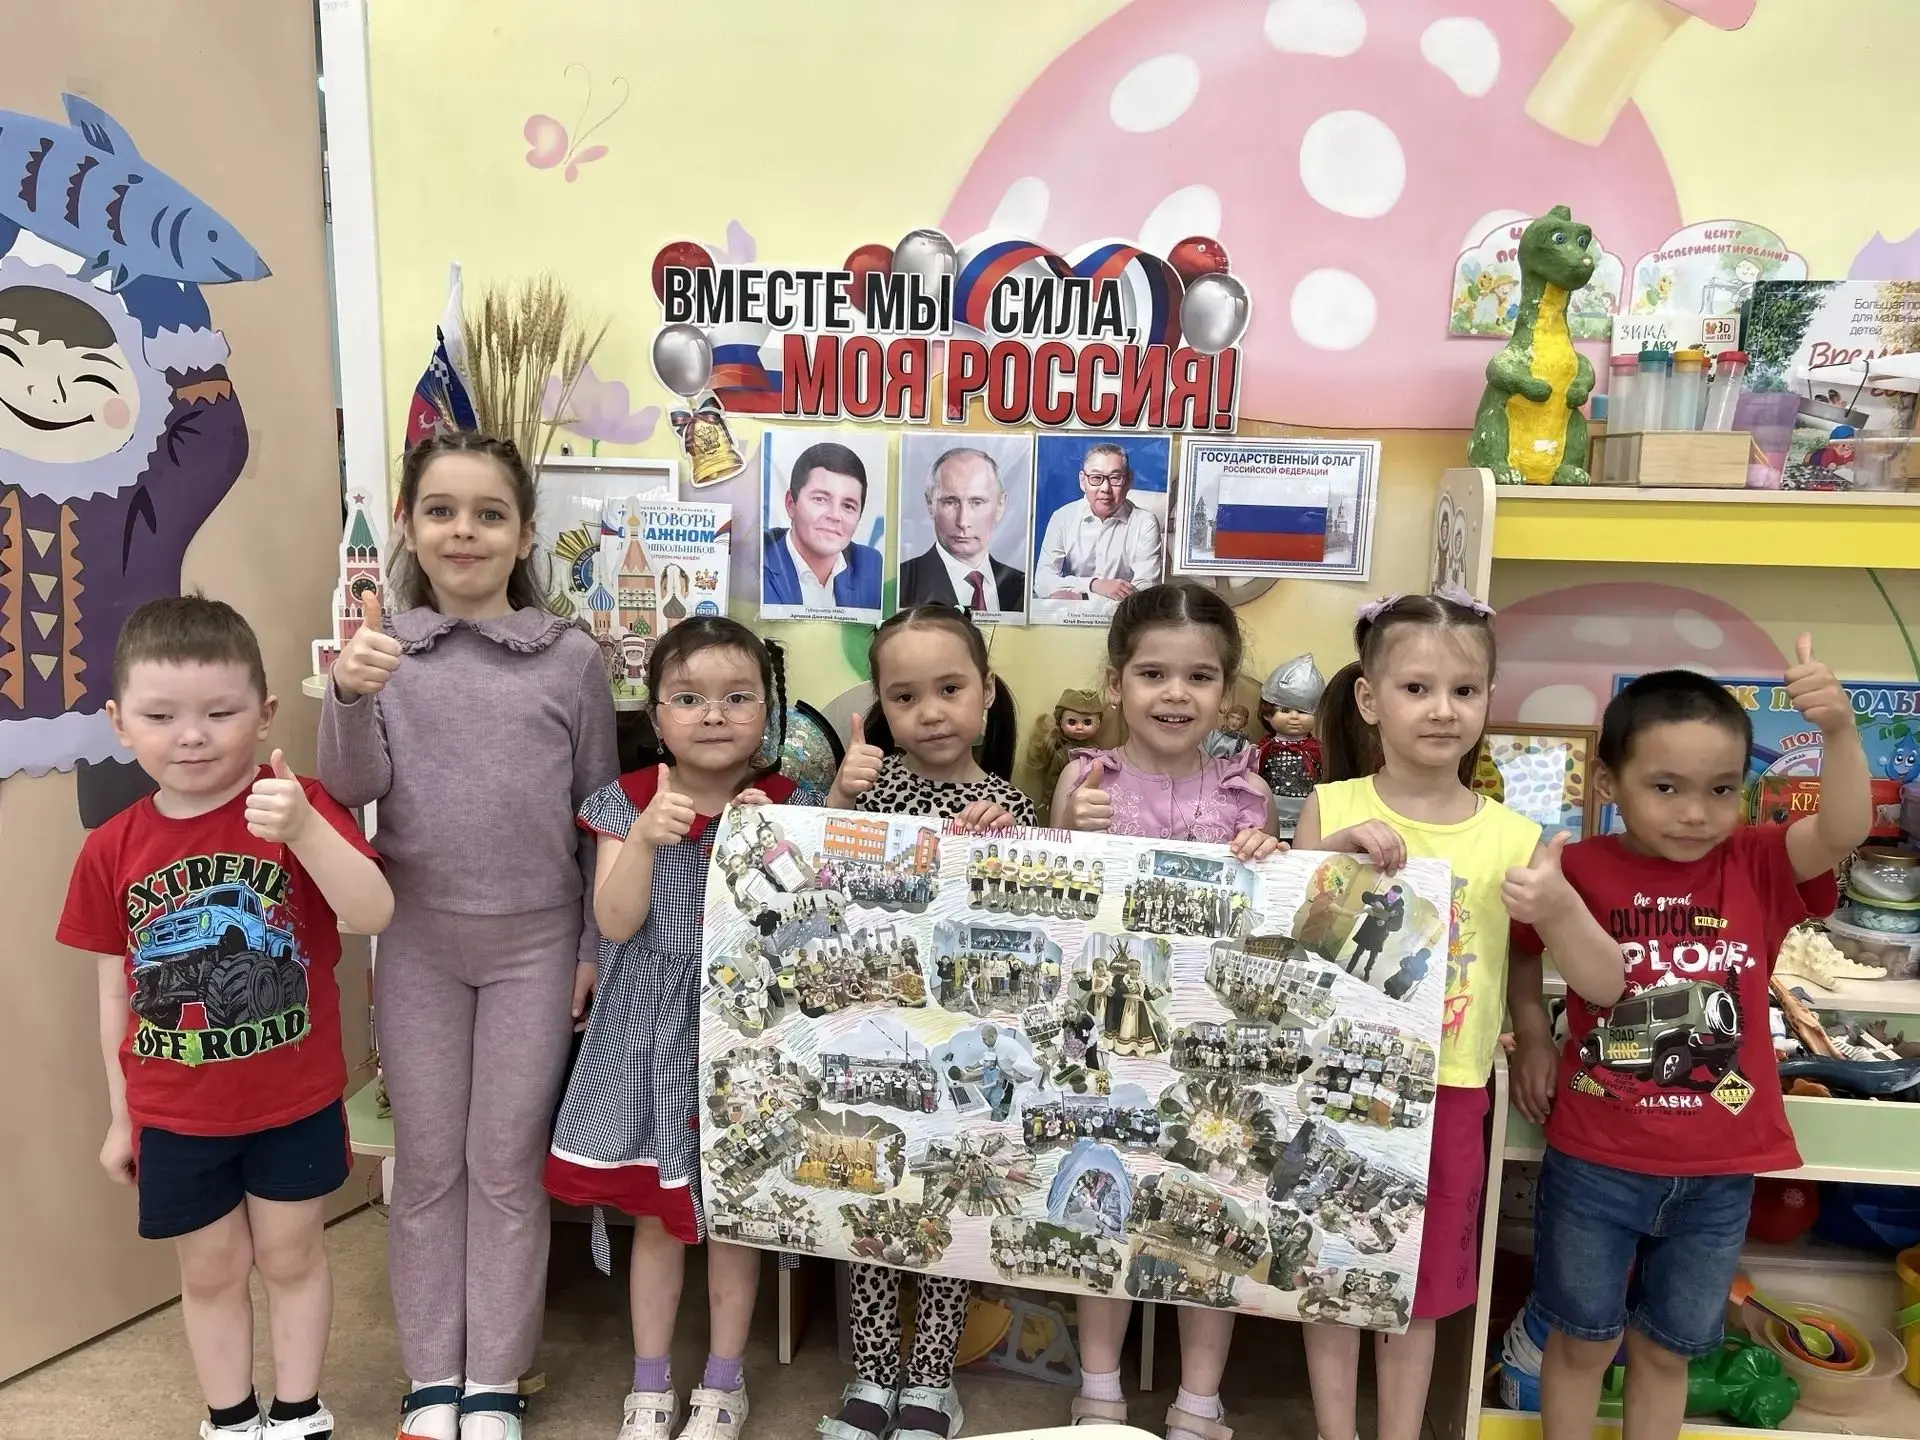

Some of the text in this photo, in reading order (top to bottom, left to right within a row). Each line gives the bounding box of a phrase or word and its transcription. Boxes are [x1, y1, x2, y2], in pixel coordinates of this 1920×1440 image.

[1704, 229, 1742, 240] ЦЕНТР
[1653, 244, 1789, 263] ЭКСПЕРИМЕНТИРОВАНИЯ
[664, 268, 1140, 344] ВМЕСТЕ МЫ СИЛА,
[1854, 299, 1905, 312] Большая
[1851, 313, 1873, 323] для
[1620, 323, 1668, 340] ЗИМА
[1717, 320, 1731, 334] 3D
[1849, 325, 1883, 336] детей
[782, 334, 1238, 430] МОЯ РОССИЯ!
[1200, 452, 1356, 467] ГОСУДАРСТВЕННЫЙ ФЛАГ
[1223, 465, 1329, 476] РОССИЙСКОЙ ФЕДЕРАЦИИ
[643, 528, 715, 543] АЖНОМ
[648, 544, 715, 554] ШКОЛЬНИКОВ
[941, 819, 1072, 844] НАША РУЖНАЯ ГРУППА
[129, 854, 289, 929] EXTREME
[1656, 893, 1692, 911] great
[137, 1009, 306, 1060] OFF ROAD
[1609, 1028, 1635, 1042] ROAD
[1608, 1042, 1640, 1059] KING
[1577, 1074, 1606, 1098] OUTDOOR
[1635, 1095, 1703, 1109] ALASKA
